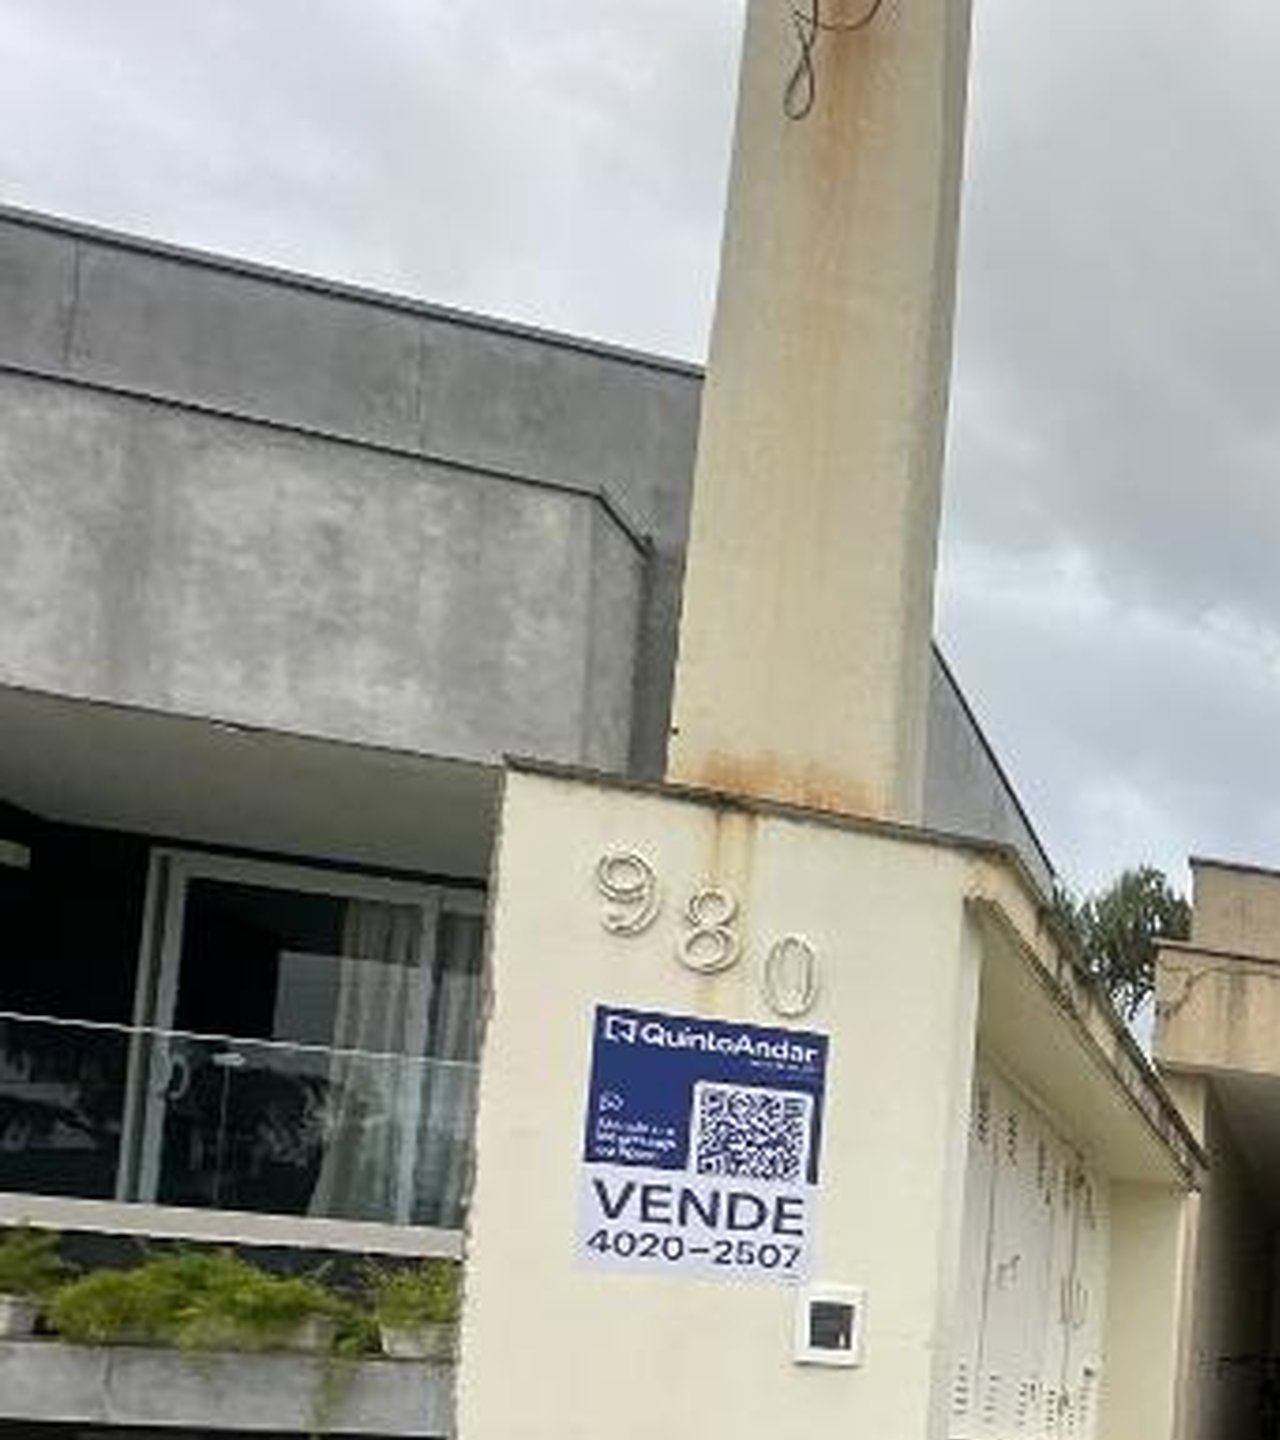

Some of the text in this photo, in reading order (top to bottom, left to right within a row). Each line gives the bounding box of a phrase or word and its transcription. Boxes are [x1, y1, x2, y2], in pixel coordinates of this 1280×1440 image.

[596, 850, 816, 1018] 980
[641, 1022, 819, 1063] QuintoAndar
[592, 1178, 804, 1236] VENDE
[587, 1229, 801, 1269] 4020-2507
